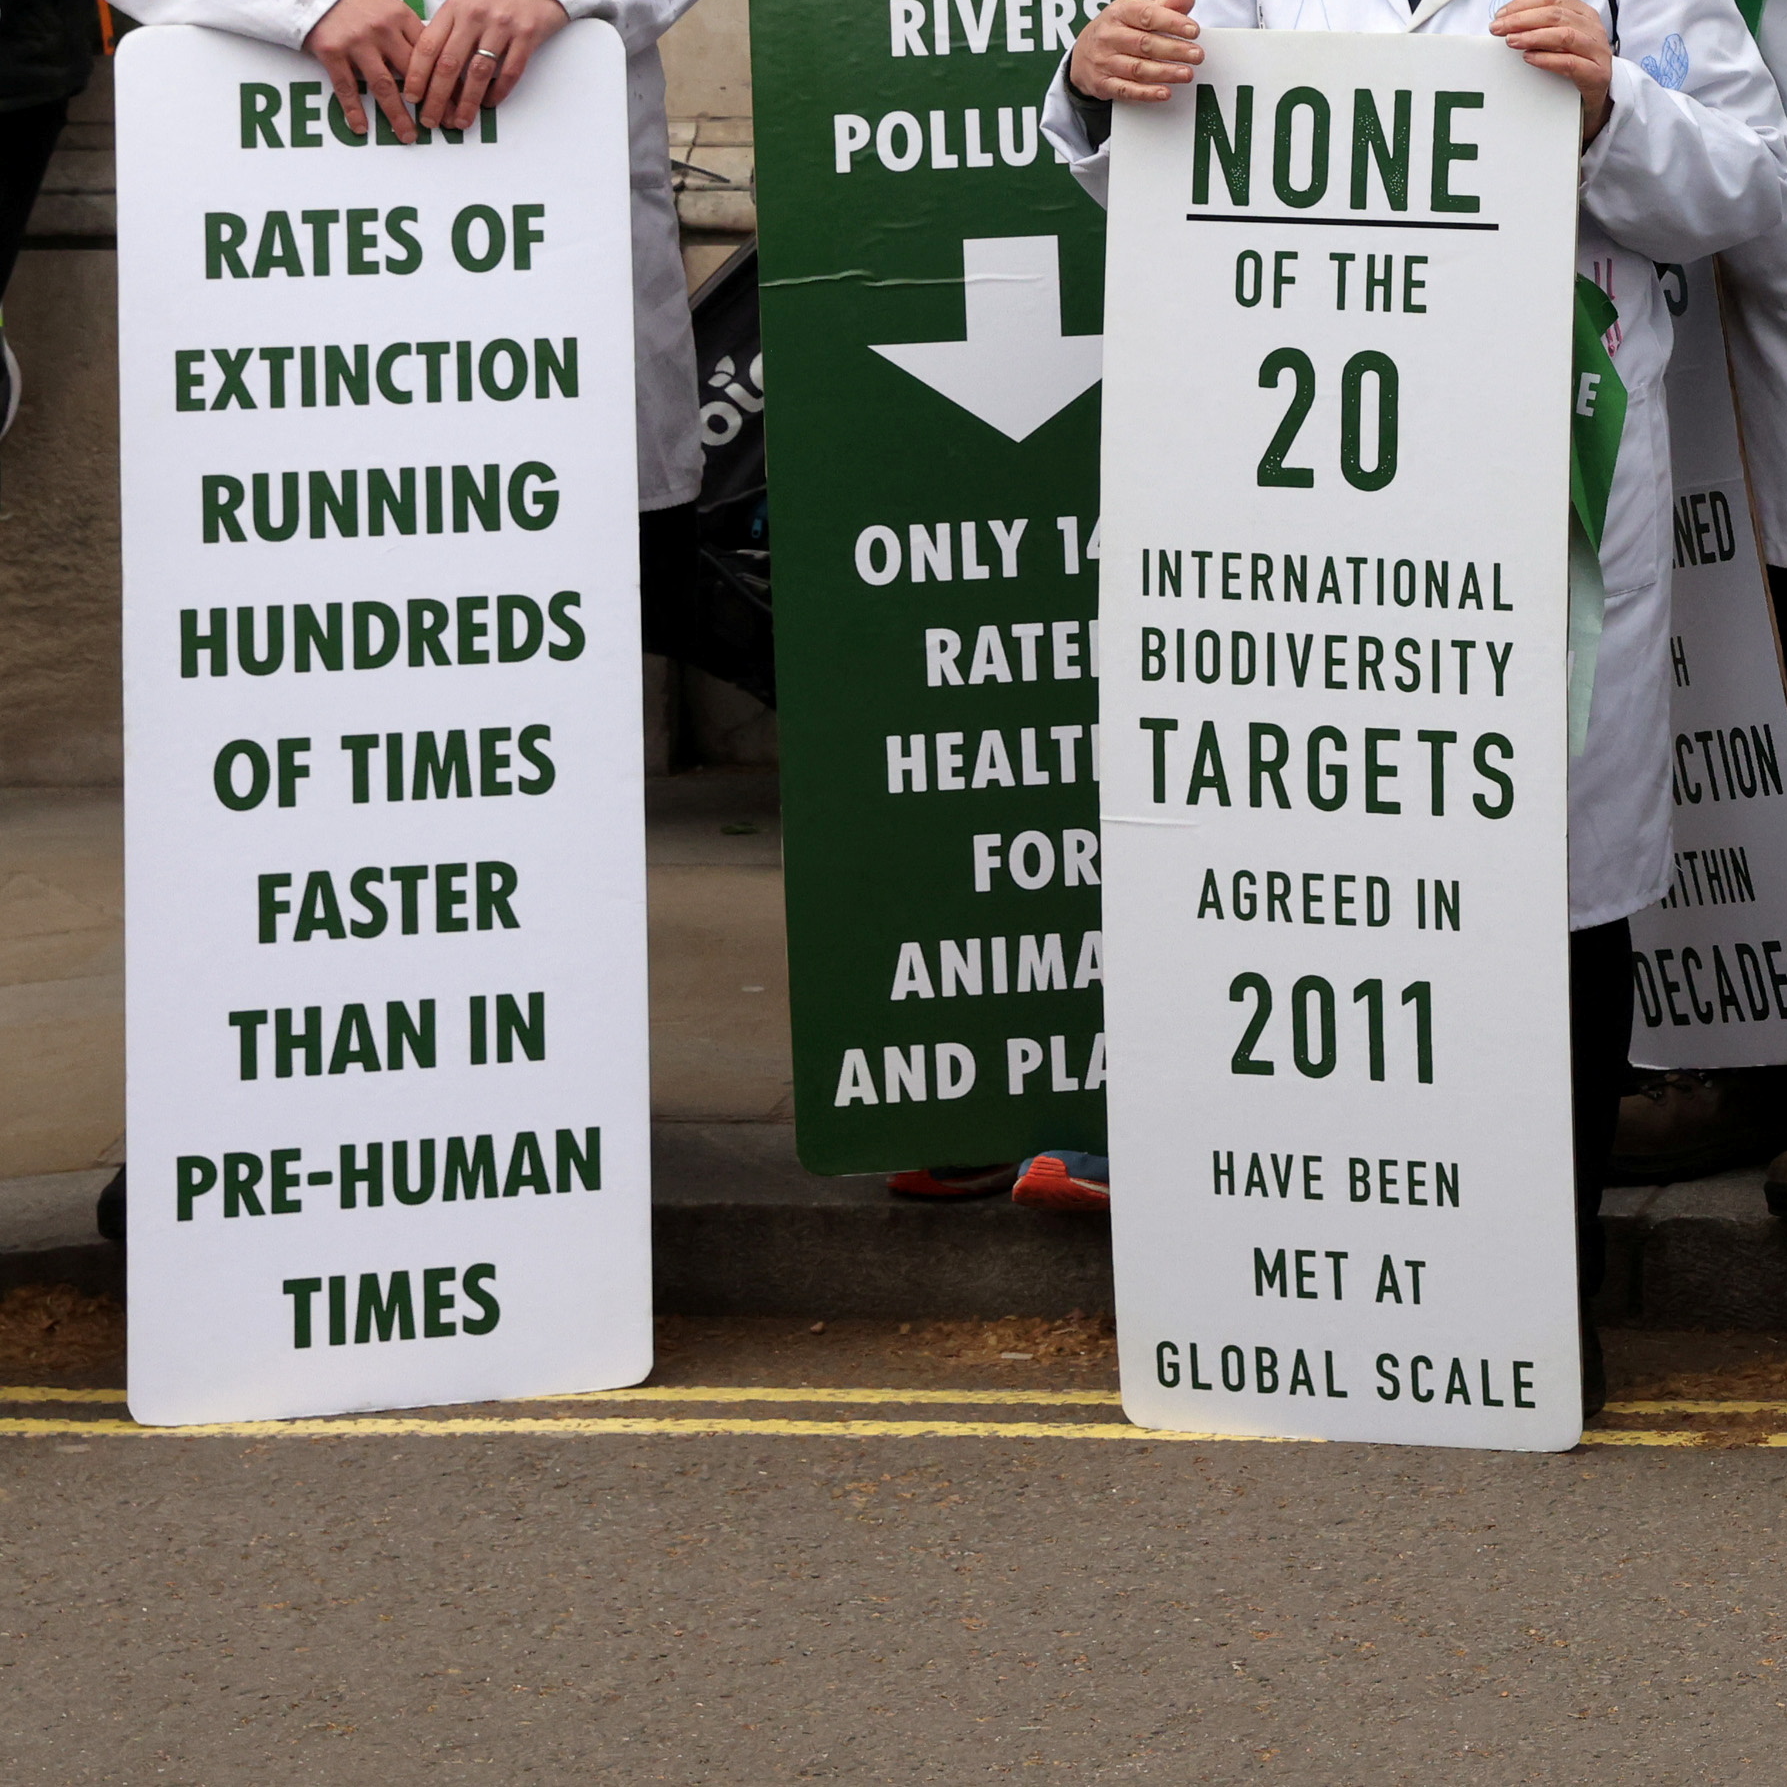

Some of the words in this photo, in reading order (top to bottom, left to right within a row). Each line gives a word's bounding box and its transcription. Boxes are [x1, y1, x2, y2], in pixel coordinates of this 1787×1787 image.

[834, 105, 1069, 174] POLLU
[1192, 83, 1484, 213] NONE
[205, 206, 422, 279] RATES
[452, 204, 544, 273] OF
[1236, 250, 1298, 308] OF
[1329, 253, 1428, 313] THE
[175, 337, 578, 412] EXTINCTION
[1257, 347, 1398, 492] 20
[202, 461, 559, 543] RUNNING
[855, 519, 1028, 585] ONLY
[1143, 549, 1513, 611] INTERNATIONAL
[180, 591, 585, 678] HUNDREDS
[925, 619, 1101, 688] RATE
[1142, 627, 1513, 696] BIODIVERSITY
[214, 737, 311, 811] OF
[341, 724, 555, 803] TIMES
[886, 723, 1099, 794] HEALT
[1140, 717, 1514, 819] TARGETS
[973, 828, 1101, 893] FOR
[258, 861, 520, 944] FASTER
[1198, 869, 1390, 927] AGREED
[1418, 879, 1460, 931] IN
[229, 999, 436, 1080] THAN
[470, 992, 545, 1065] IN
[1229, 972, 1433, 1084] 2011
[835, 1043, 975, 1106] AND
[177, 1127, 601, 1221] PRE-HUMAN
[1213, 1151, 1323, 1200] HAVE
[1349, 1158, 1459, 1207] BEEN
[283, 1263, 500, 1349] TIMES
[1254, 1248, 1348, 1300] MET
[1376, 1255, 1425, 1304] AT
[1157, 1341, 1347, 1398] GLOBAL
[1376, 1353, 1535, 1408] SCALE
